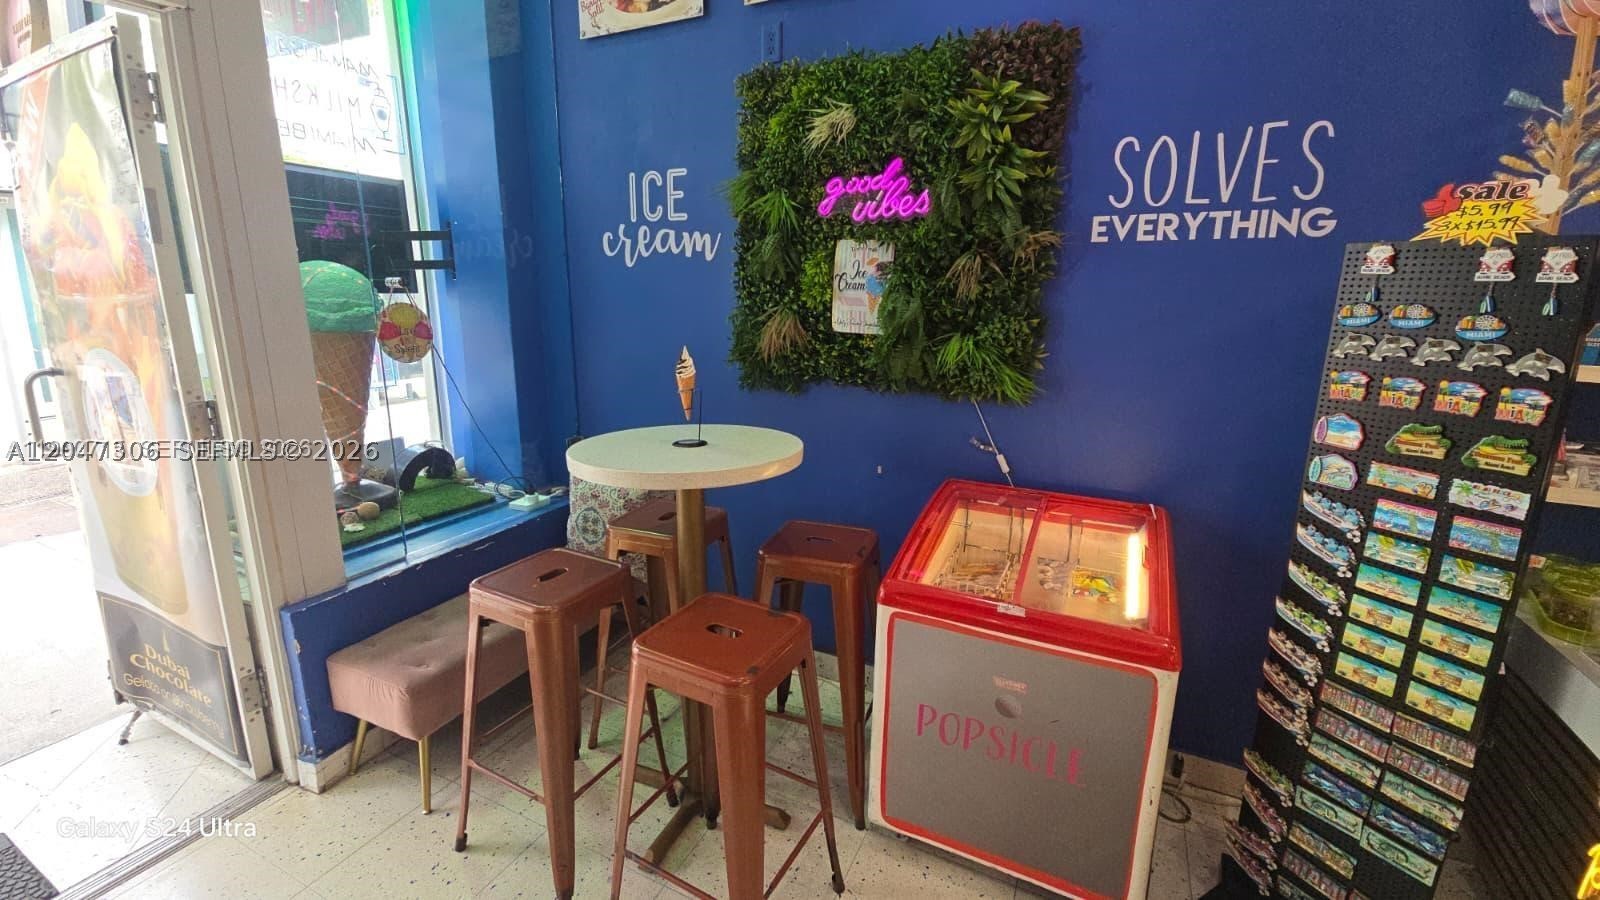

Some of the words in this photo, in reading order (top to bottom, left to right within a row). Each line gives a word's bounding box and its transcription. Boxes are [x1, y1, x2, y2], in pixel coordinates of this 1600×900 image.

[817, 156, 904, 217] good
[1108, 120, 1335, 209] SOLVES
[629, 168, 688, 222] ICE
[851, 175, 931, 223] vibes
[1459, 181, 1529, 200] sale
[602, 223, 721, 267] cream
[1090, 207, 1337, 242] EVERYTHING
[1346, 317, 1371, 326] MIAMI
[1397, 319, 1424, 327] MIAMI
[1466, 330, 1496, 338] MIAMI
[129, 652, 212, 705] Chocolate
[144, 643, 191, 681] Dubai
[916, 703, 1086, 788] POPSICLE
